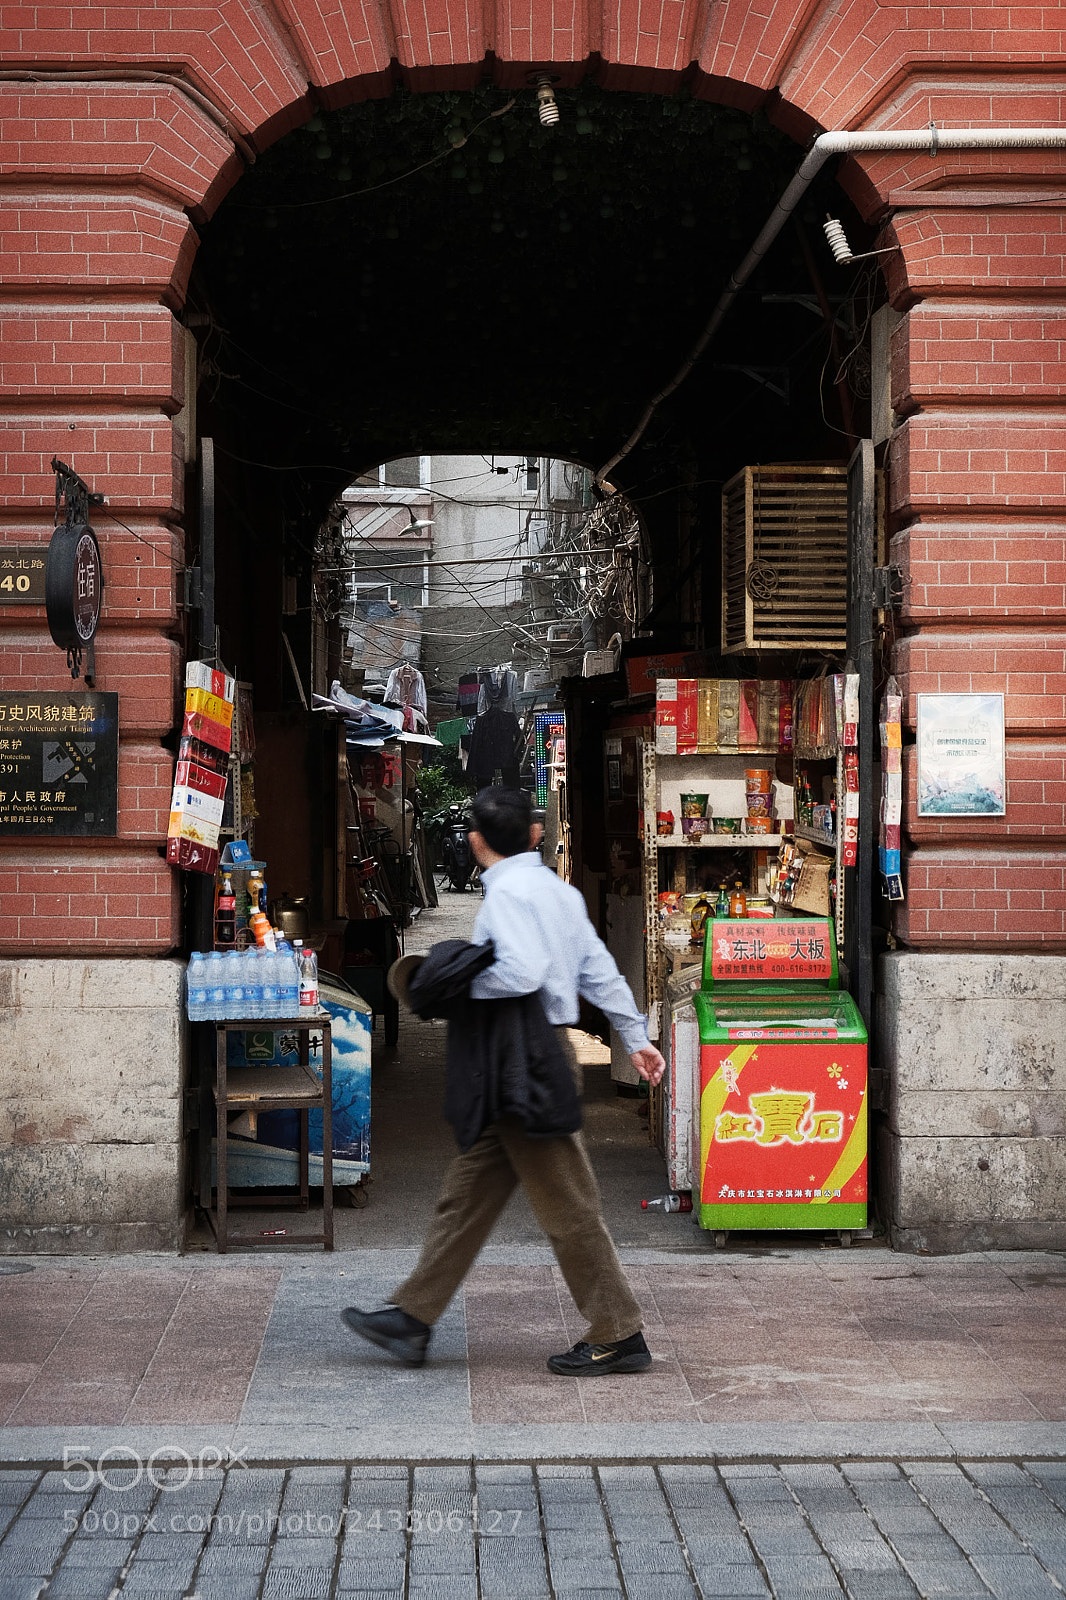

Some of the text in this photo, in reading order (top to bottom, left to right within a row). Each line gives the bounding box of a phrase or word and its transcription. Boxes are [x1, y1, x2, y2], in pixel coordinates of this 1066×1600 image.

[1, 559, 45, 569] 放北路
[0, 575, 31, 592] 40
[70, 725, 93, 734] Tianjin
[0, 739, 22, 750] 保护
[0, 763, 19, 774] 391
[0, 790, 66, 803] 市人民政府
[731, 939, 767, 961] 东北
[789, 938, 826, 960] 大板
[771, 964, 827, 973] 400-616-8172
[718, 1189, 841, 1198] 大庆市红宝石冰淇淋有限公司
